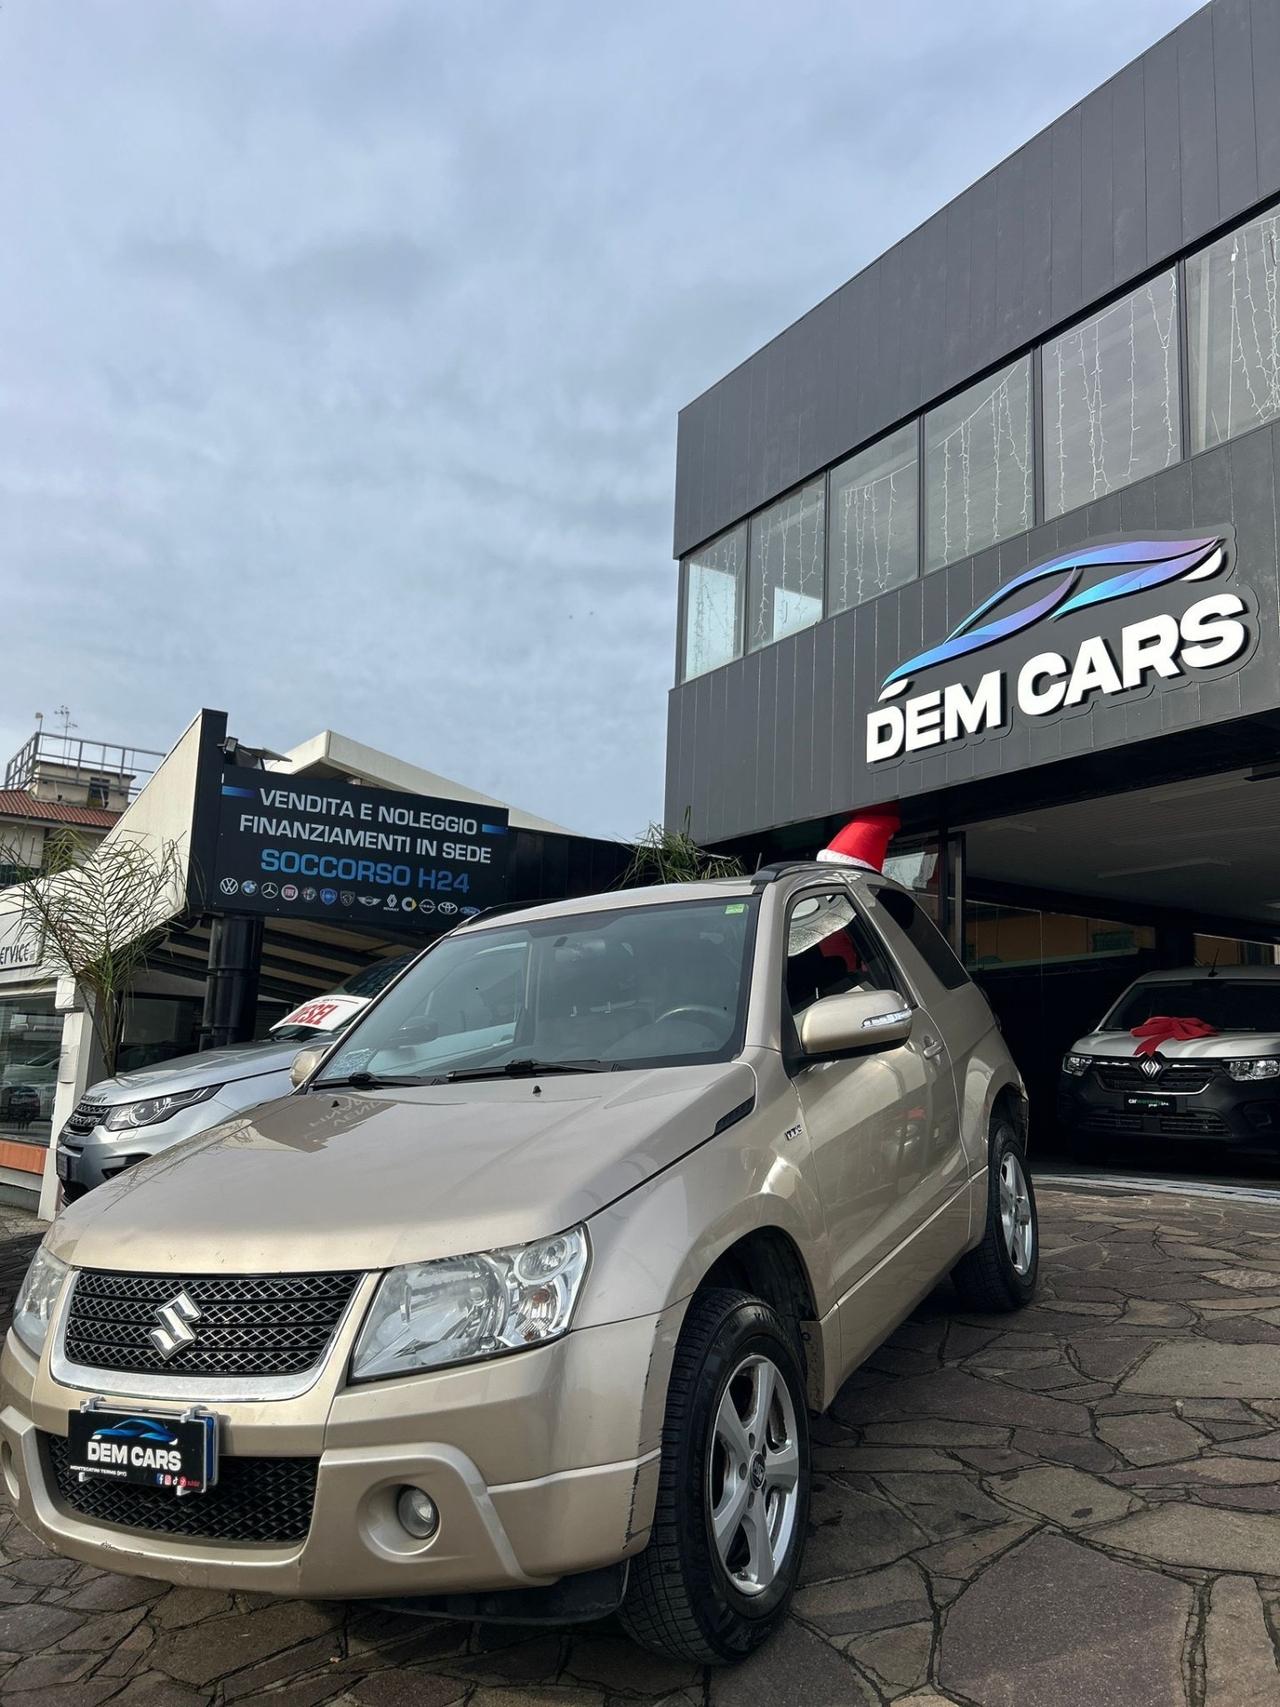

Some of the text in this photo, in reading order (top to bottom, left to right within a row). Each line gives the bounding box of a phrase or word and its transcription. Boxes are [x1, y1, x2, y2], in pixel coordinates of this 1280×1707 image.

[866, 593, 1246, 764] DEM CARS
[259, 787, 478, 836] VENDITA E NOLEGGIO
[239, 815, 492, 864] FINANZIAMENTI IN SEDE
[260, 848, 470, 893] SOCCORSO H24
[87, 1441, 181, 1472] DEM CARS
